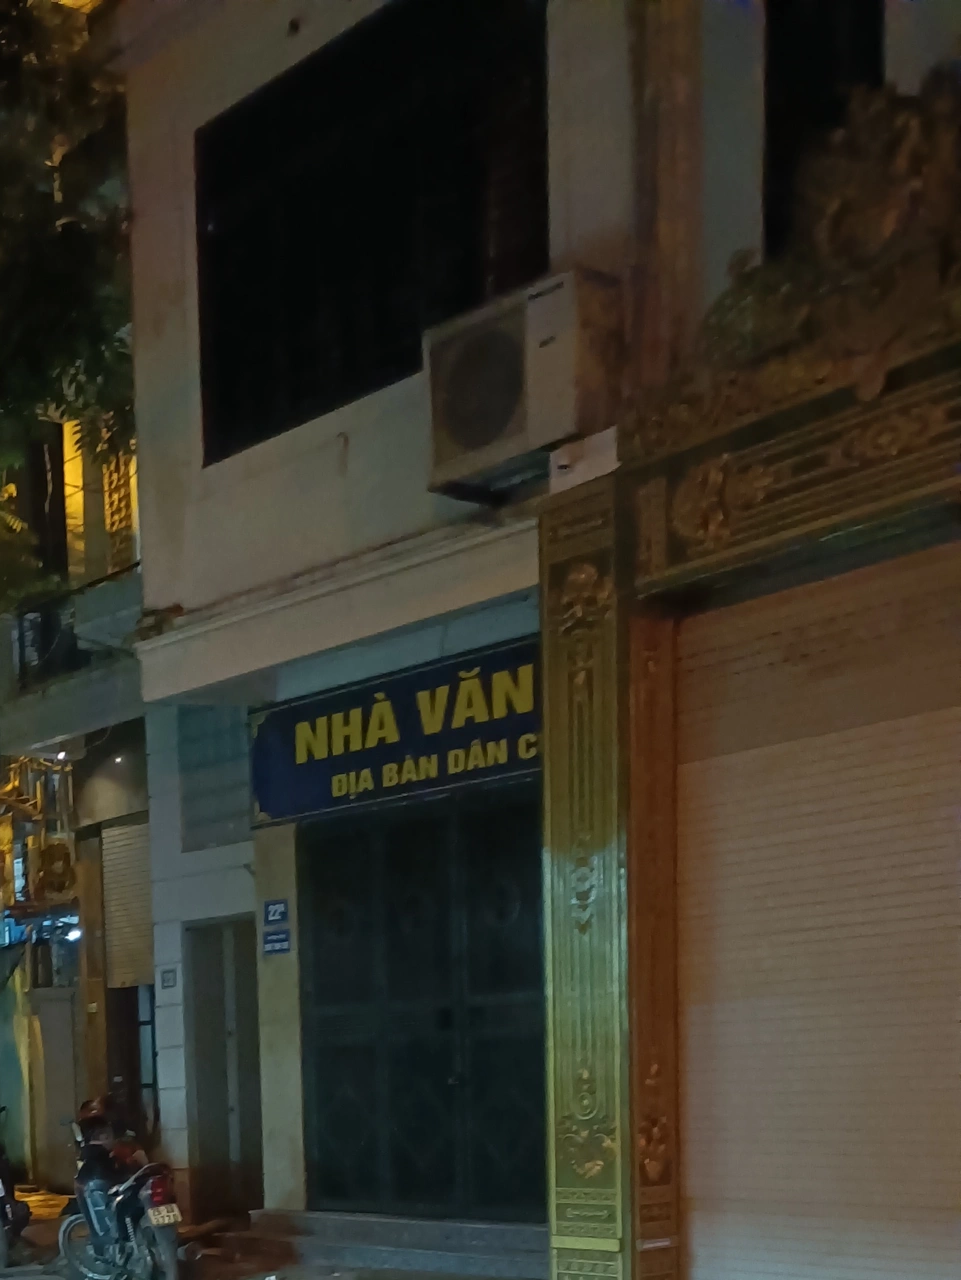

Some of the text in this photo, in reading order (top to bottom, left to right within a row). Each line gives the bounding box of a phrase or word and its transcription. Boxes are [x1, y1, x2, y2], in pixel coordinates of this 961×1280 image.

[295, 663, 534, 764] NHÀ VĂN
[447, 738, 508, 775] DÂN
